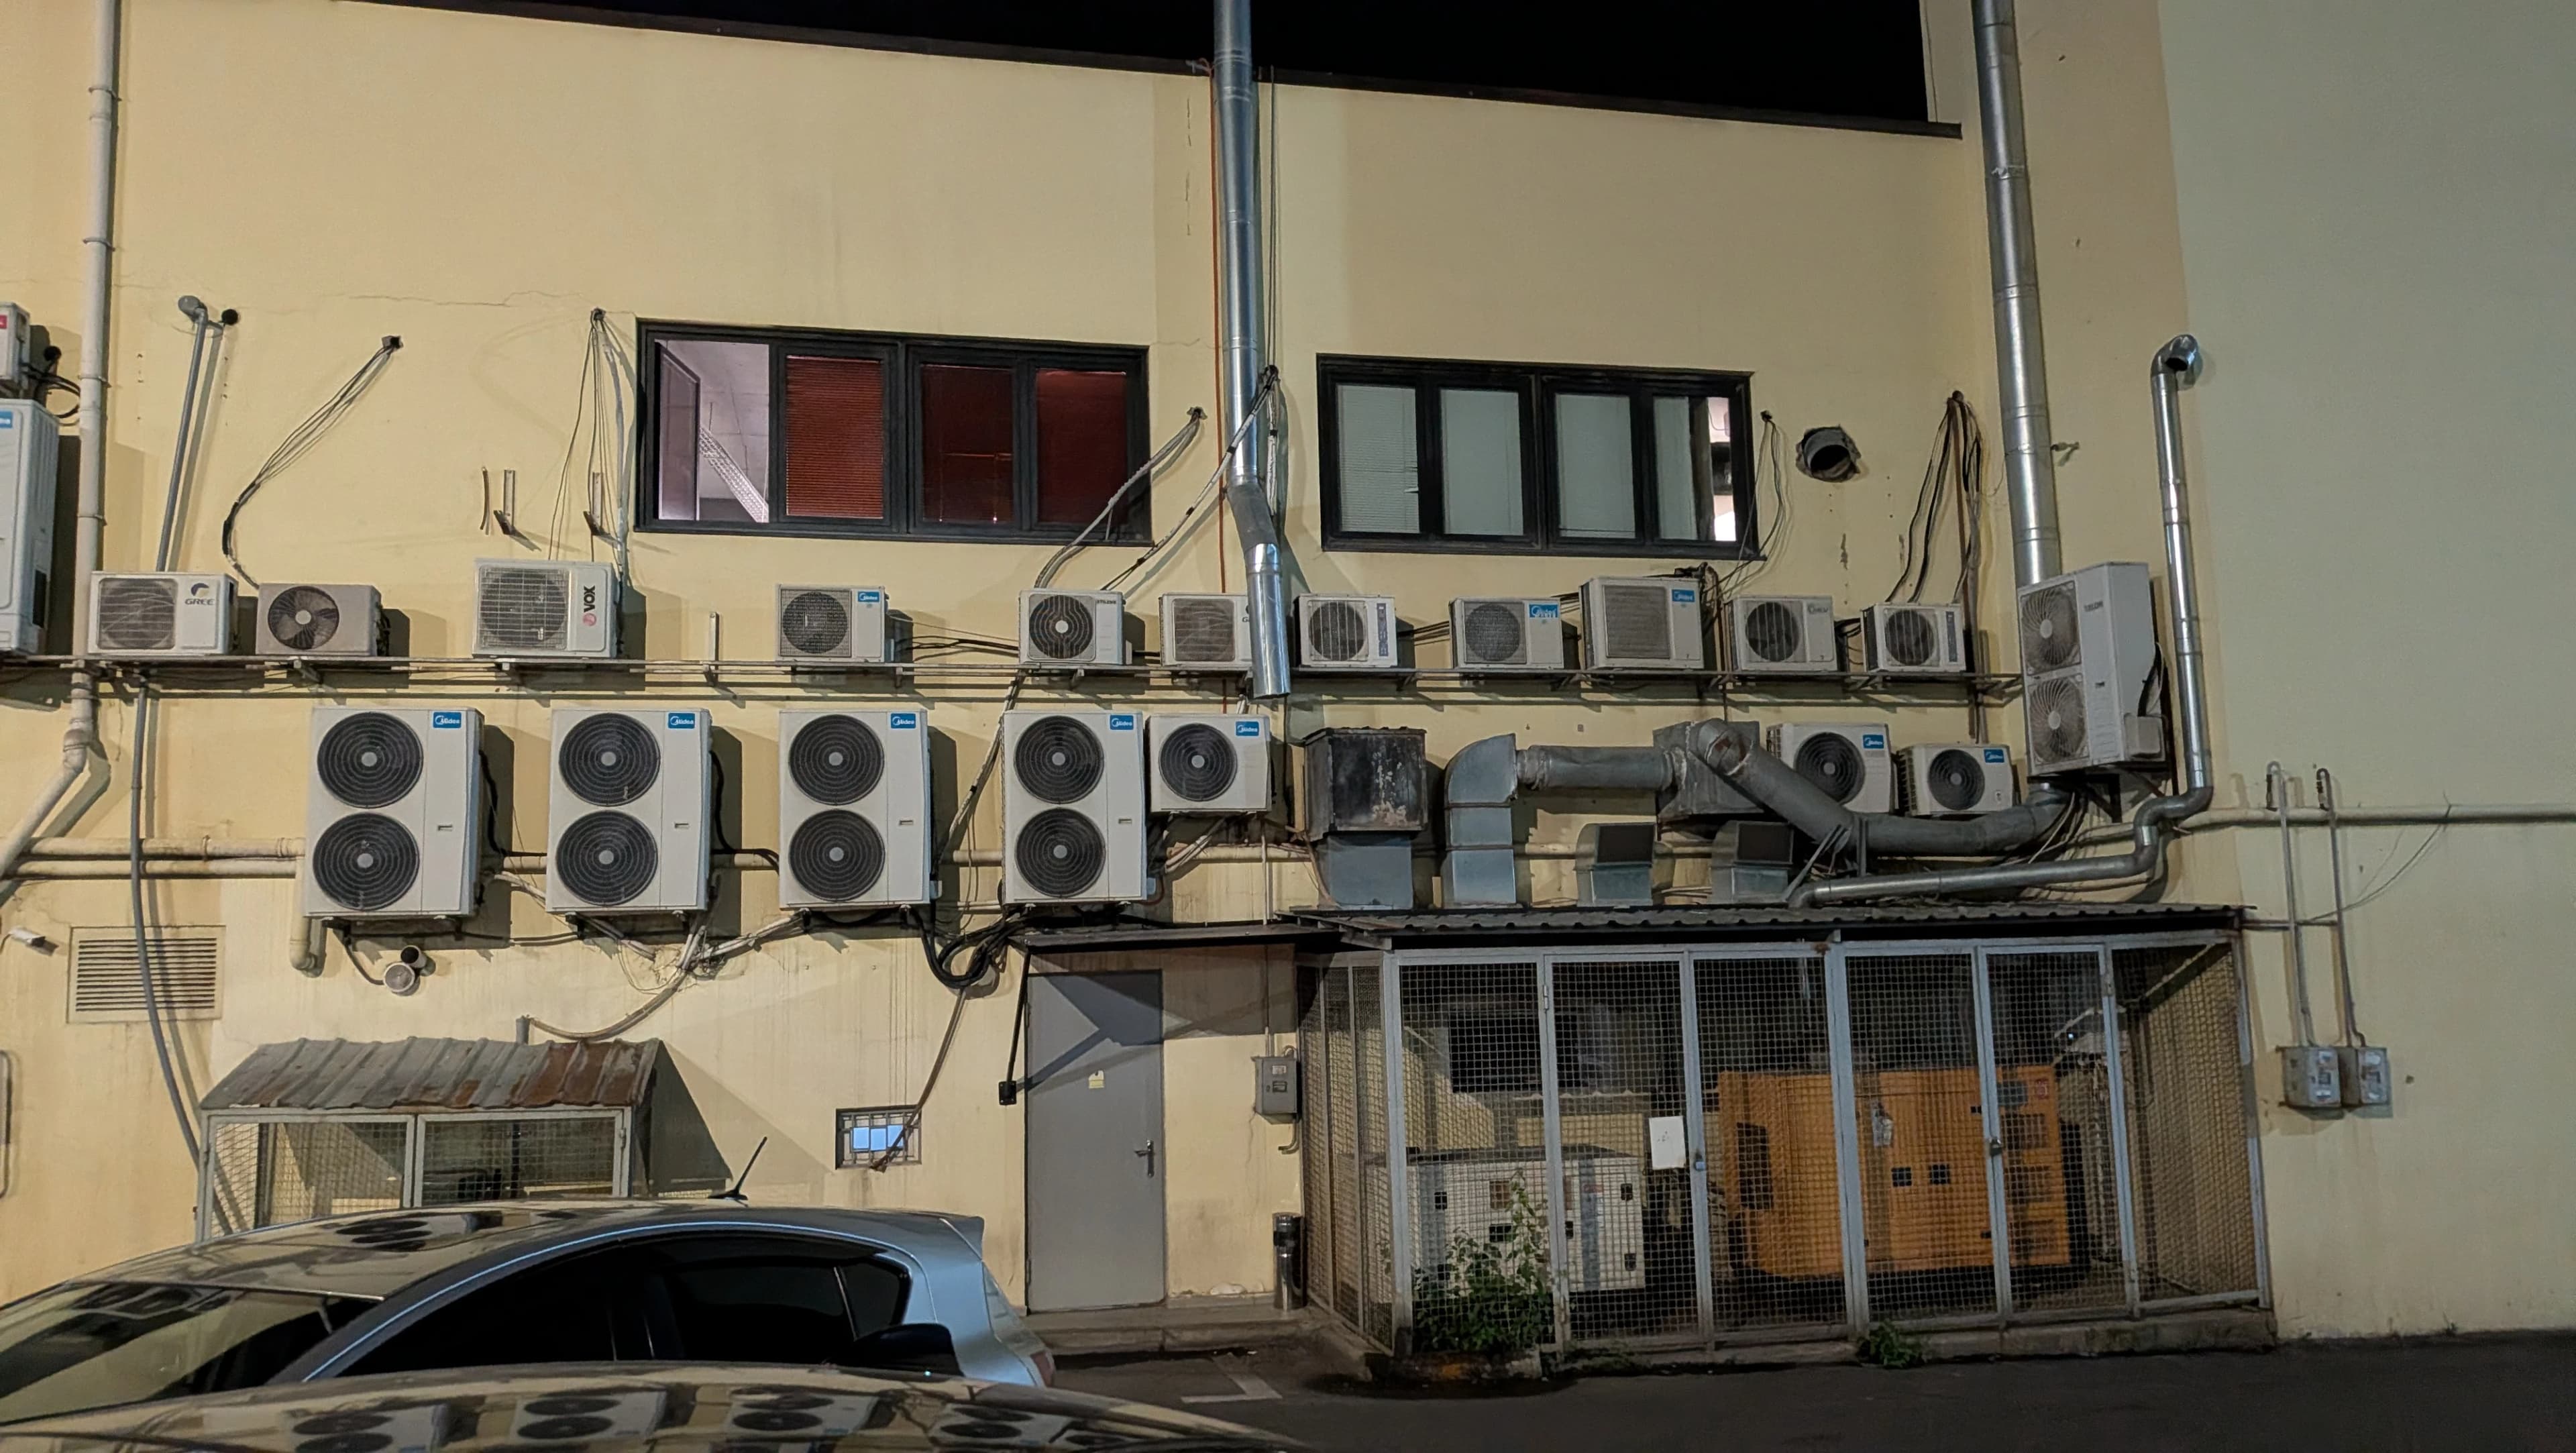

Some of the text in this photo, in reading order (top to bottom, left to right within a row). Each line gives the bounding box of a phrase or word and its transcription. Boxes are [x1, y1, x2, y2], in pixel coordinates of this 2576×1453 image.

[584, 586, 595, 612] VOX
[437, 716, 460, 724] Midea
[894, 717, 914, 725] Midea
[1113, 718, 1132, 726] Midea
